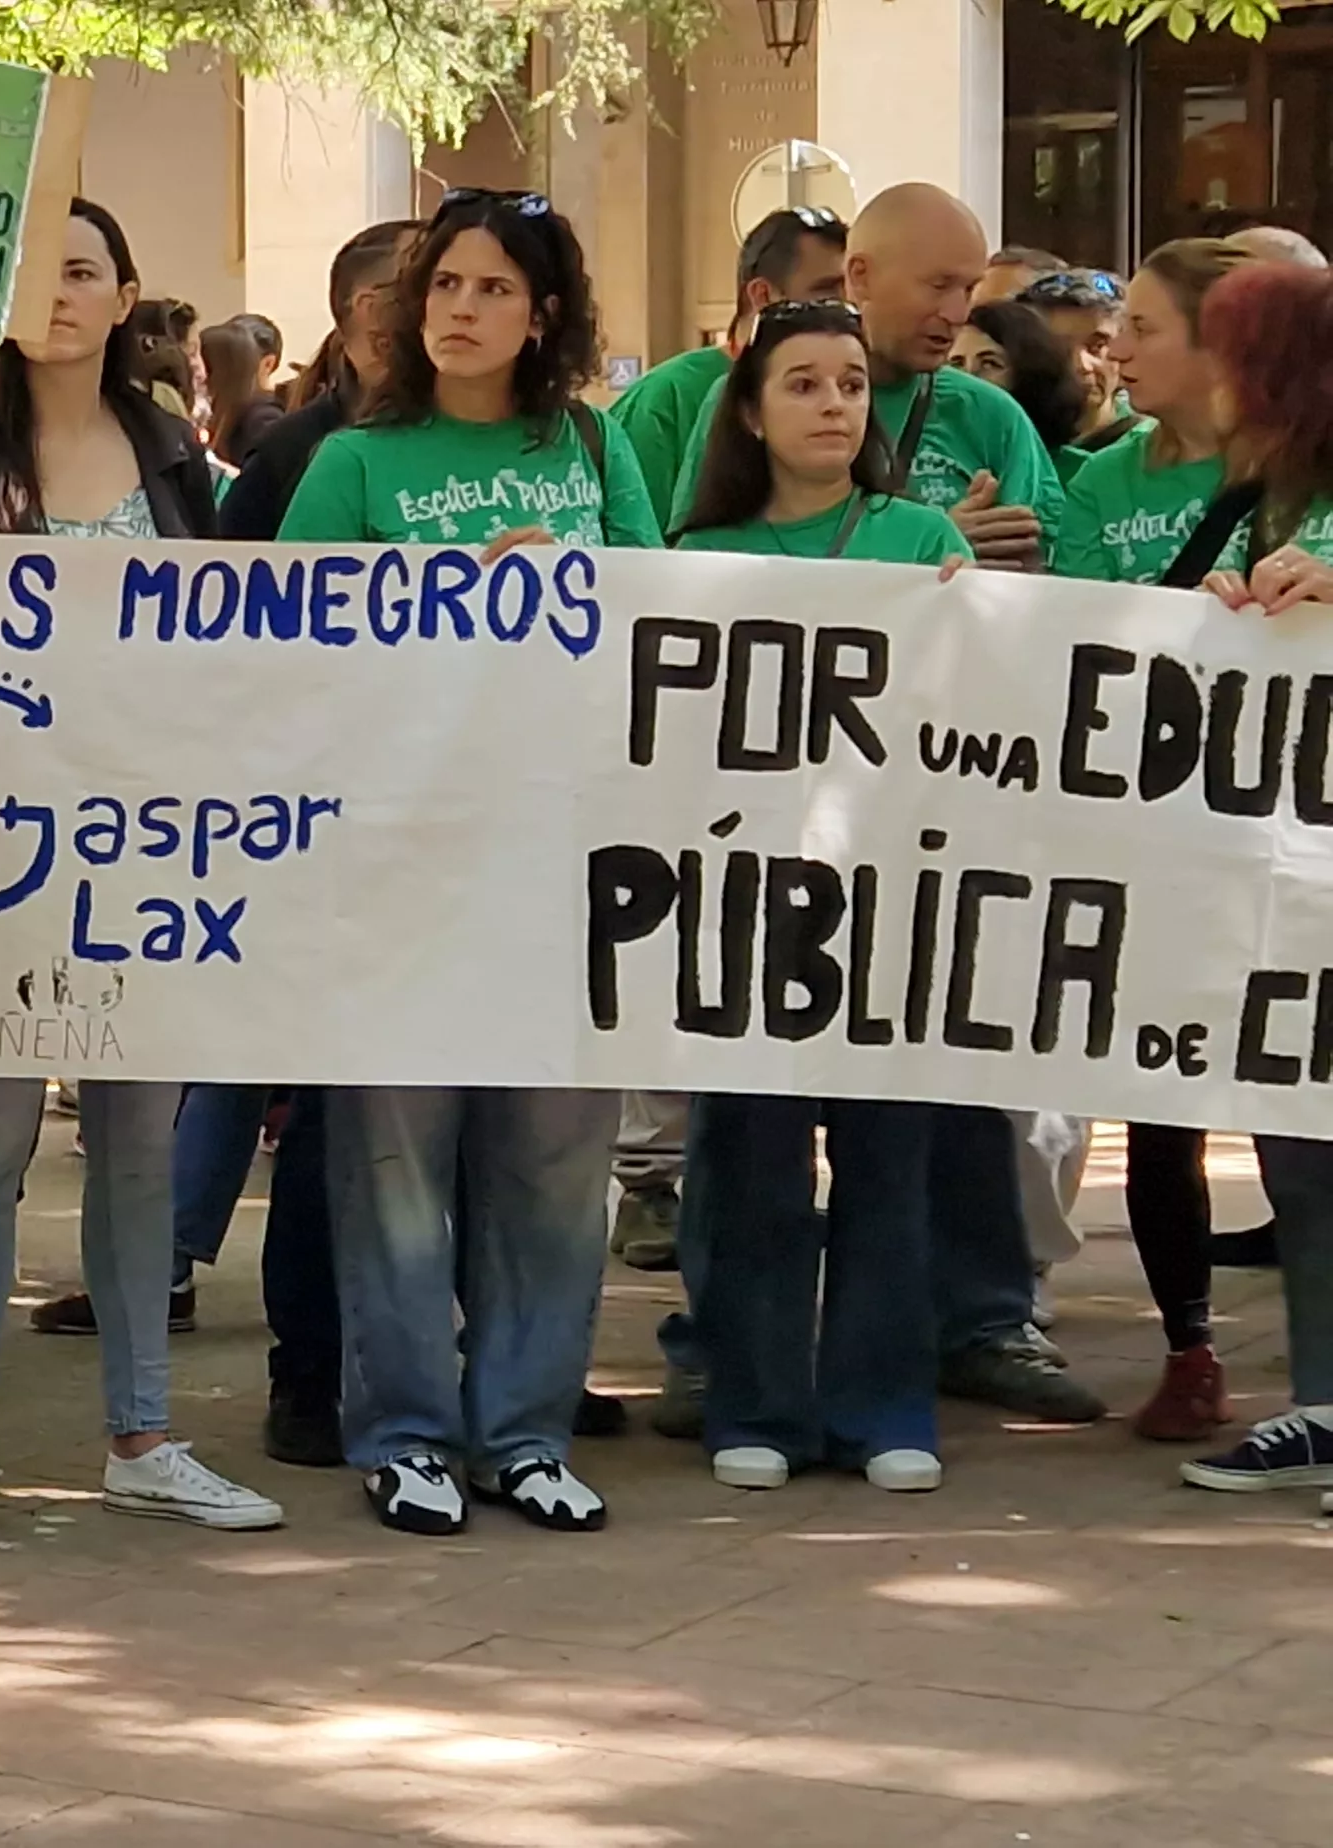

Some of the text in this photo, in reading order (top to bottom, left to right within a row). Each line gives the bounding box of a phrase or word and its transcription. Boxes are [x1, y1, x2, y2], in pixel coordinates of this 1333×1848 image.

[401, 476, 513, 523] ESCUELA
[1102, 509, 1192, 546] SCUELA
[118, 548, 602, 659] MONEGROS
[630, 617, 889, 772] POR
[919, 723, 1038, 792] UNA
[72, 879, 248, 964] Lax
[587, 811, 1128, 1059] PÚBLICA
[1136, 1023, 1209, 1077] DE
